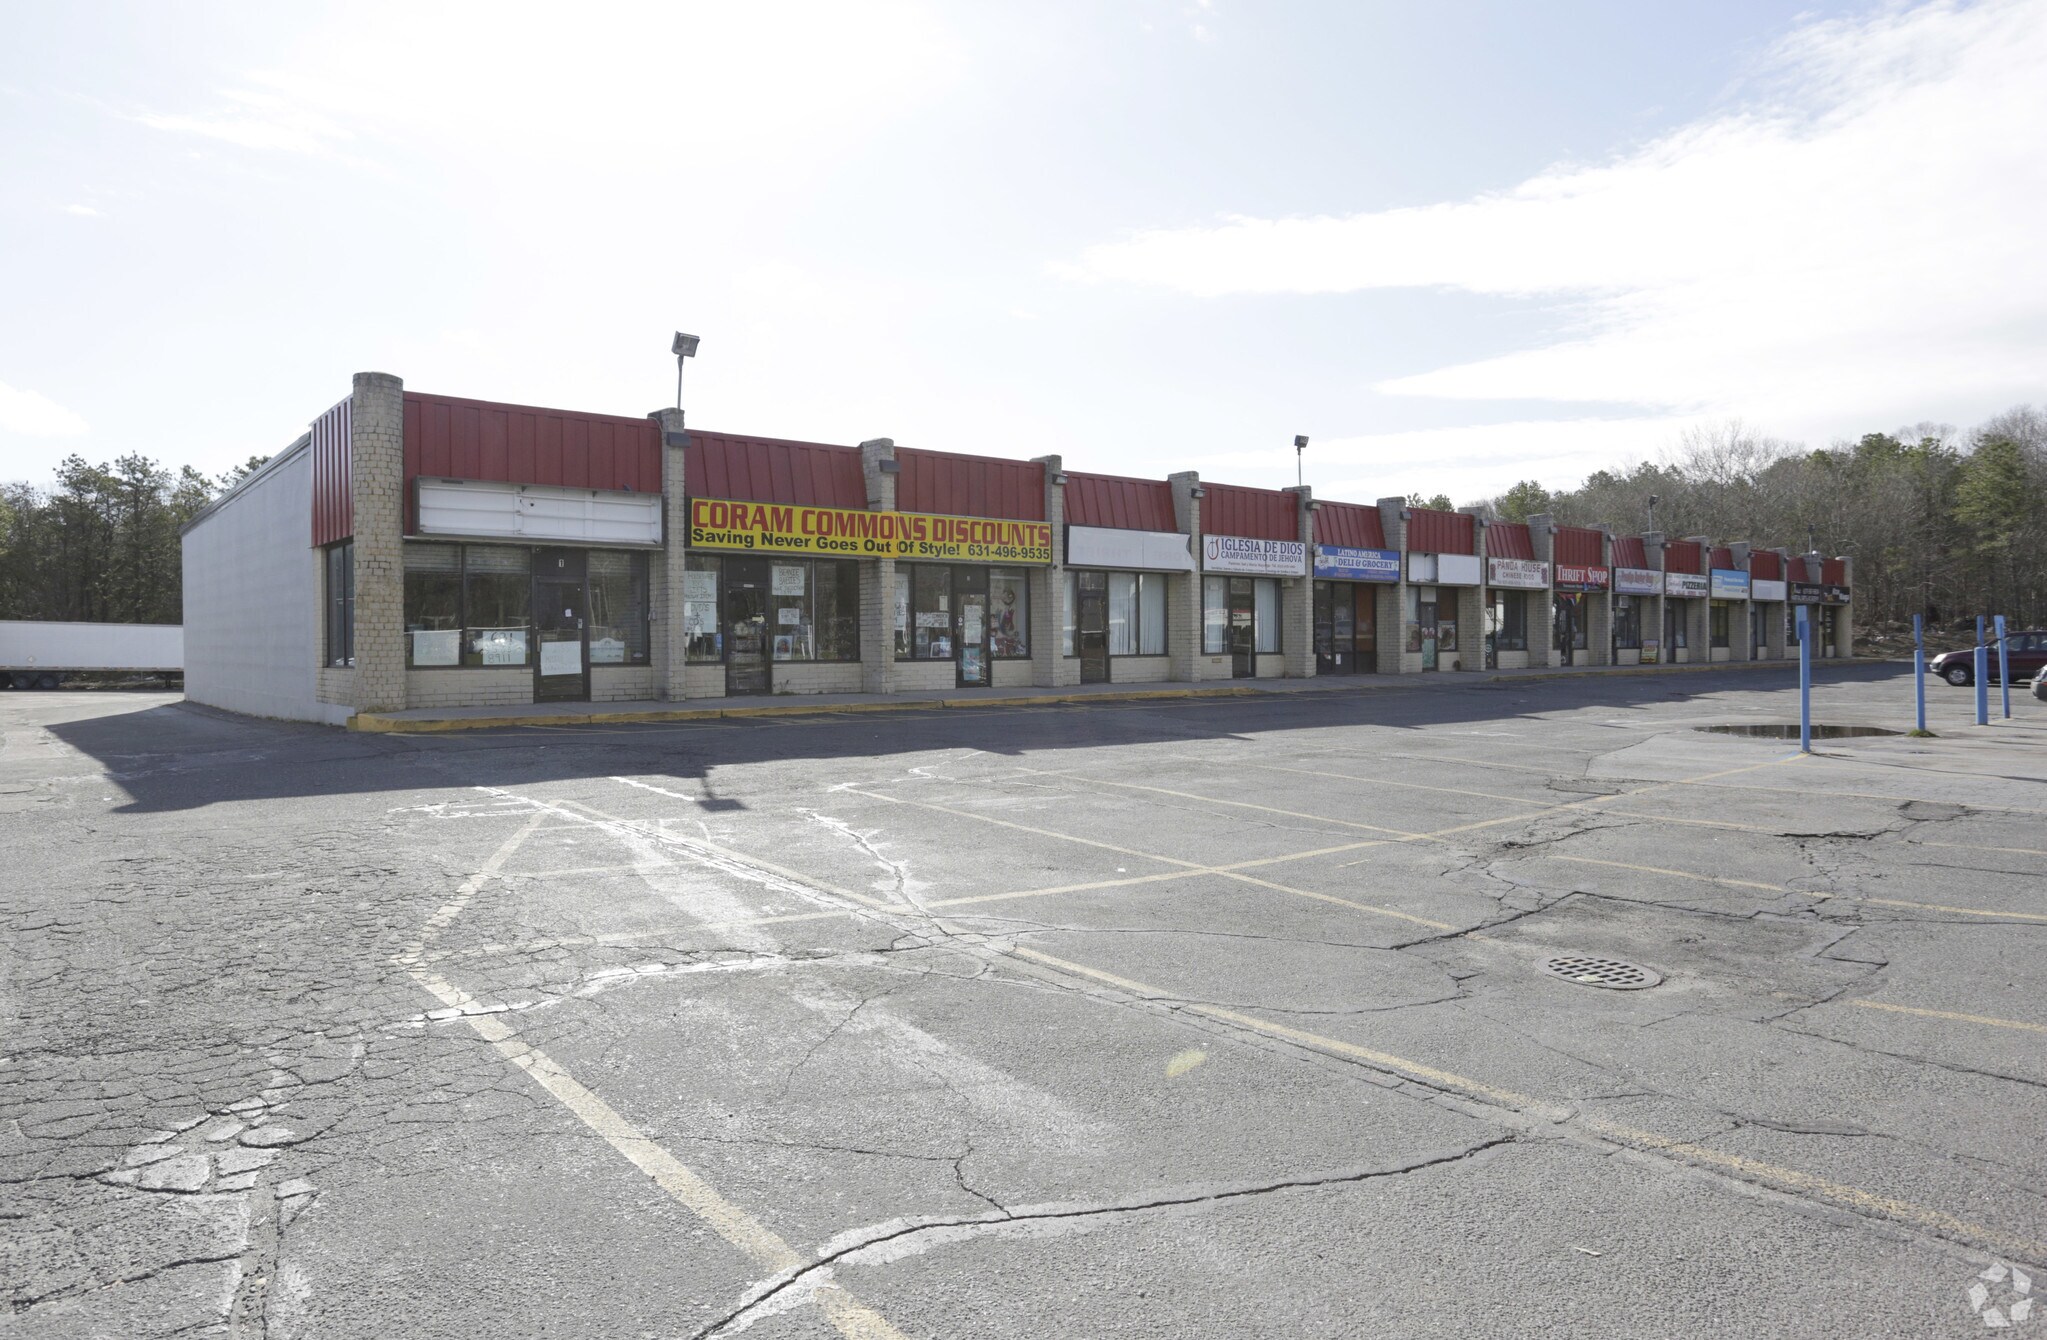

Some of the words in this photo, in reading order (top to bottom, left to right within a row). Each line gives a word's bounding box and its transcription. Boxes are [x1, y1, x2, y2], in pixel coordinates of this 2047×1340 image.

[692, 500, 794, 534] CORAM
[801, 509, 927, 542] COMMONS
[932, 518, 1050, 548] DISCOUNTS
[692, 528, 754, 548] Saving
[761, 532, 811, 547] Never
[816, 536, 858, 552] Goes
[863, 539, 892, 553] Out
[897, 540, 910, 555] Of
[919, 541, 960, 558] Style!
[968, 544, 1050, 560] 631-496-9535
[1221, 538, 1261, 553] IGLESIA
[1264, 541, 1278, 554] DE
[1280, 542, 1303, 555] DIOS
[1220, 551, 1267, 562] CAMPAMENTO
[1269, 554, 1277, 562] DE
[1279, 554, 1302, 563] JEHOVA
[1337, 548, 1358, 557] LATINO
[1338, 559, 1354, 567] DELI
[1362, 560, 1393, 569] GROCERY
[1497, 560, 1518, 571] PANDA
[1521, 562, 1541, 573] HOUSE
[1556, 565, 1586, 582] THRIFT
[1587, 567, 1608, 583] SHOP
[1681, 581, 1707, 590] PIZZERIA
